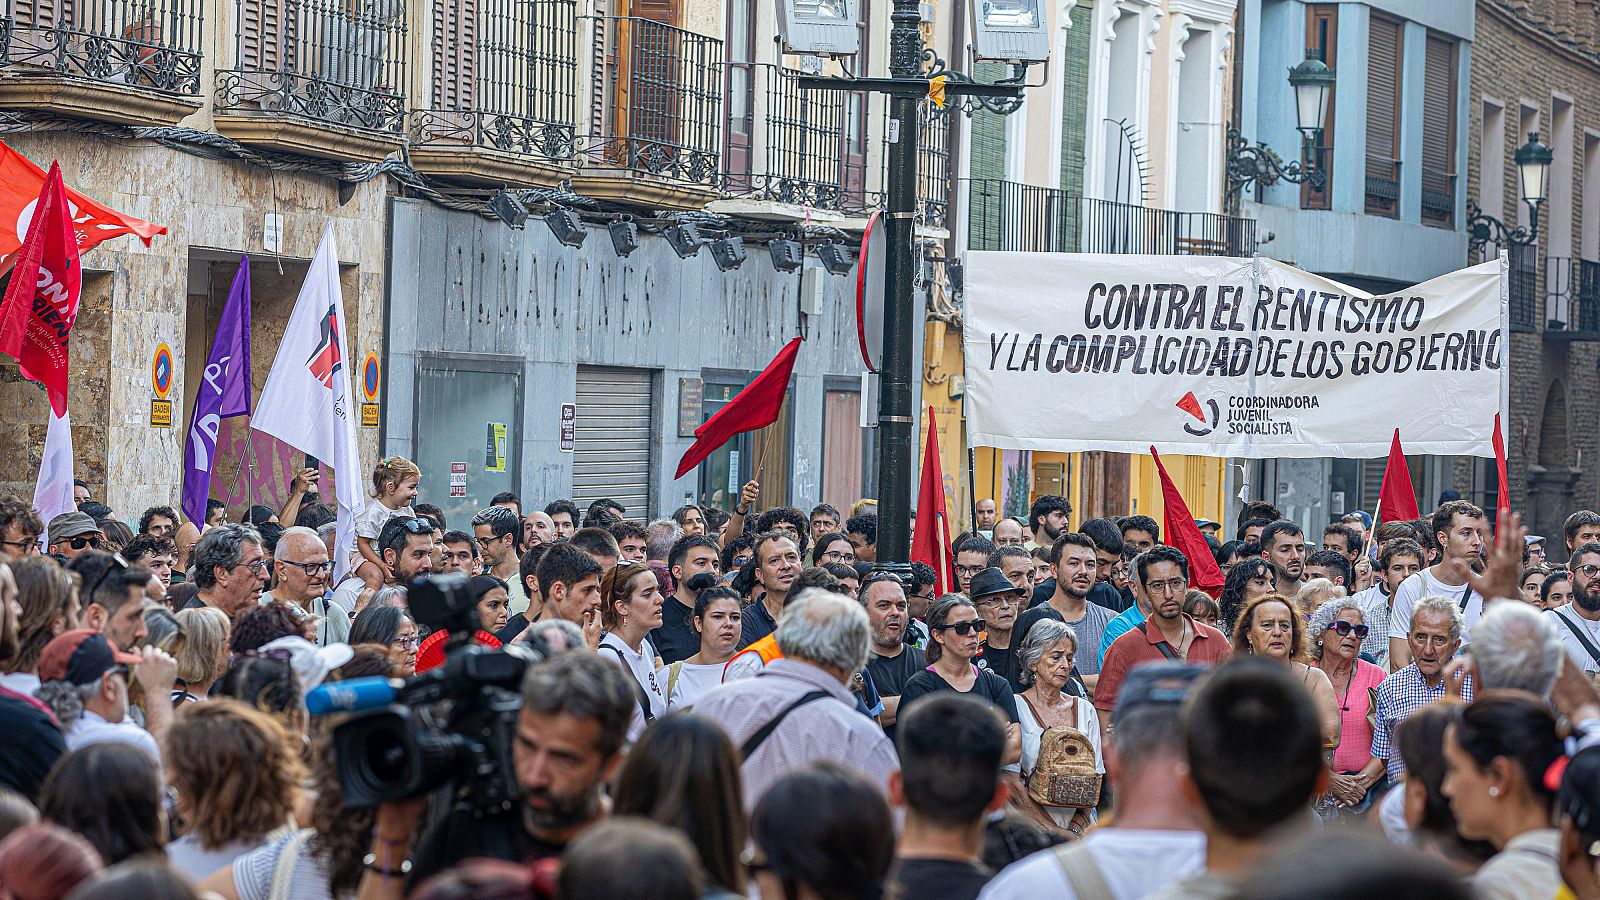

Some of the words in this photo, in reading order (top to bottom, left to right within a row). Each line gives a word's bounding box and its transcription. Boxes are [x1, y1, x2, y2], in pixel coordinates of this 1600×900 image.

[1084, 282, 1208, 331] CONTRA
[1210, 284, 1246, 332] EL
[1251, 284, 1426, 334] RENTISMO
[989, 332, 1008, 372] Y
[1006, 333, 1043, 372] LA
[1045, 333, 1252, 377] COMPLICIDAD
[1254, 335, 1293, 378] DE
[1290, 339, 1346, 380] LOS
[1228, 395, 1320, 409] COORDINADORA
[1226, 409, 1273, 423] JUVENIL
[1227, 421, 1294, 436] SOCIALISTA
